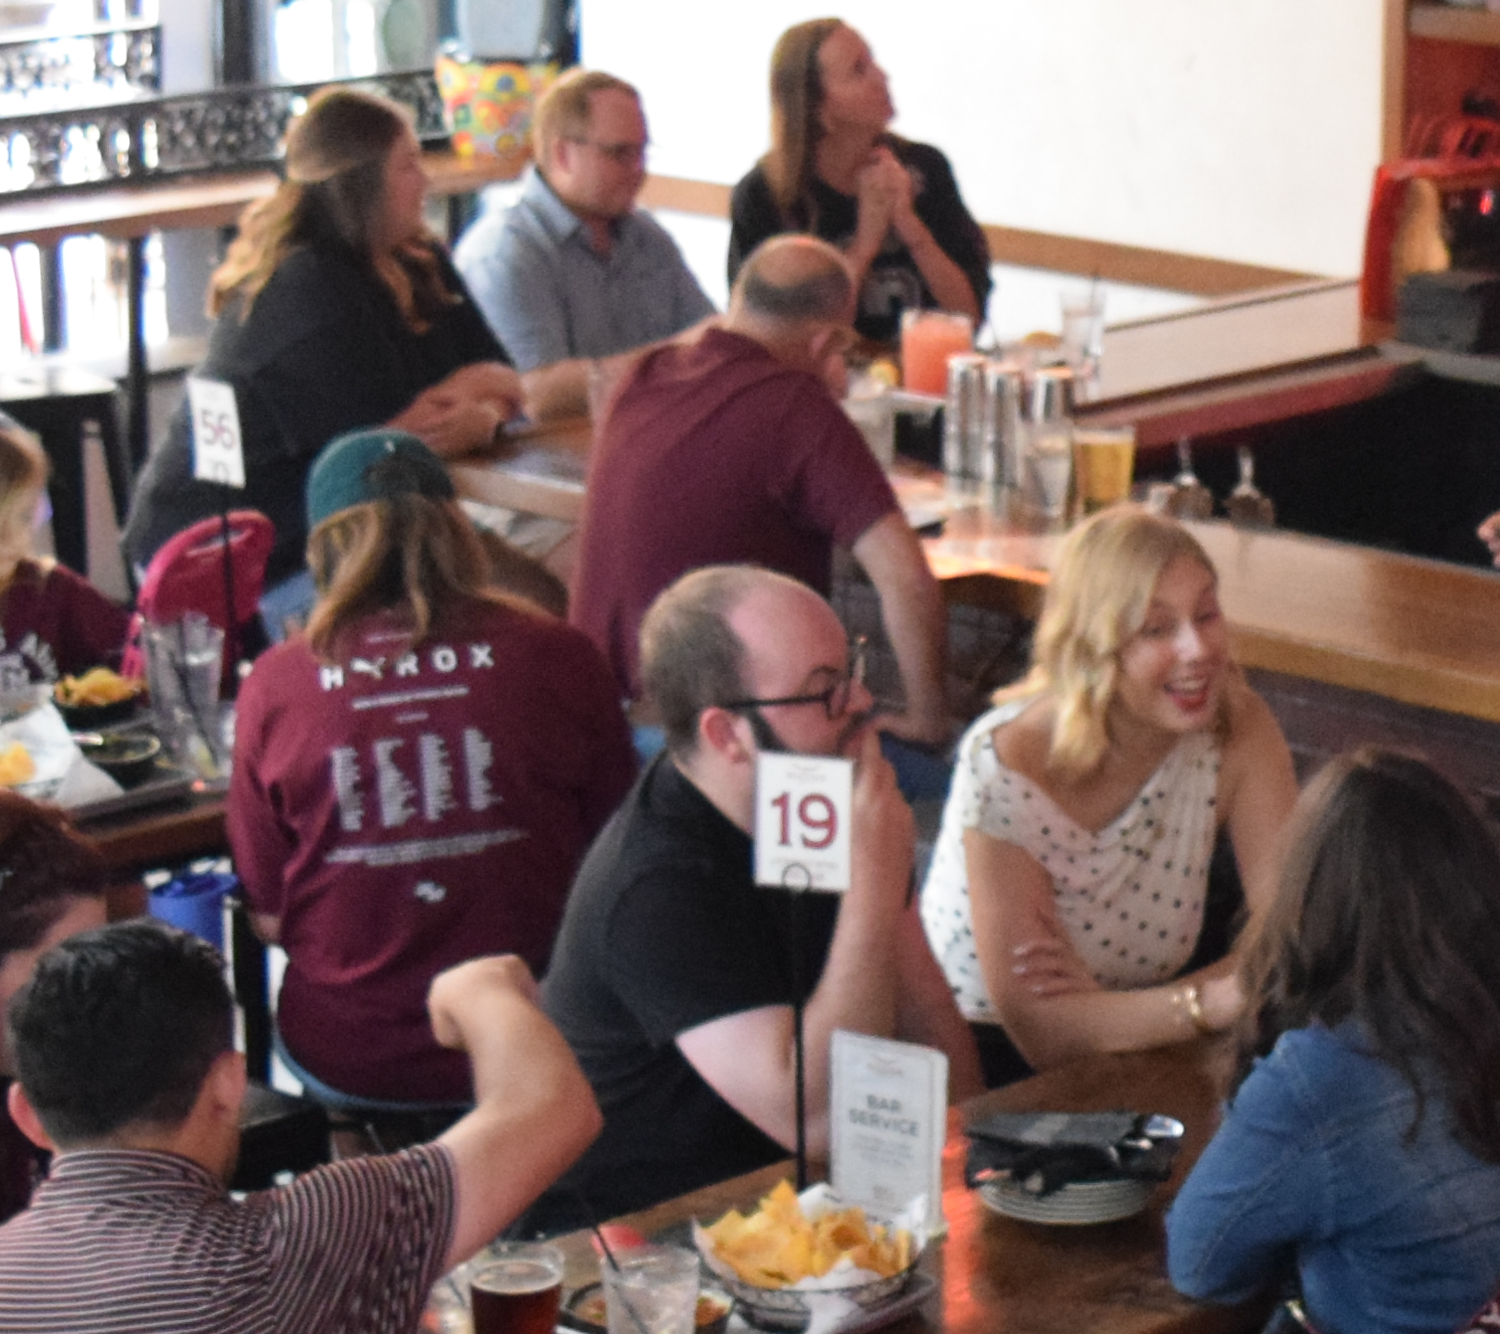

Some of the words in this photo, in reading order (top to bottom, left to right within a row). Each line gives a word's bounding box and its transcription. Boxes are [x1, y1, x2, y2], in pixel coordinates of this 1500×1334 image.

[201, 407, 237, 451] 56
[770, 791, 839, 849] 19
[865, 1094, 902, 1113] BAR
[847, 1108, 921, 1137] SERVICE
